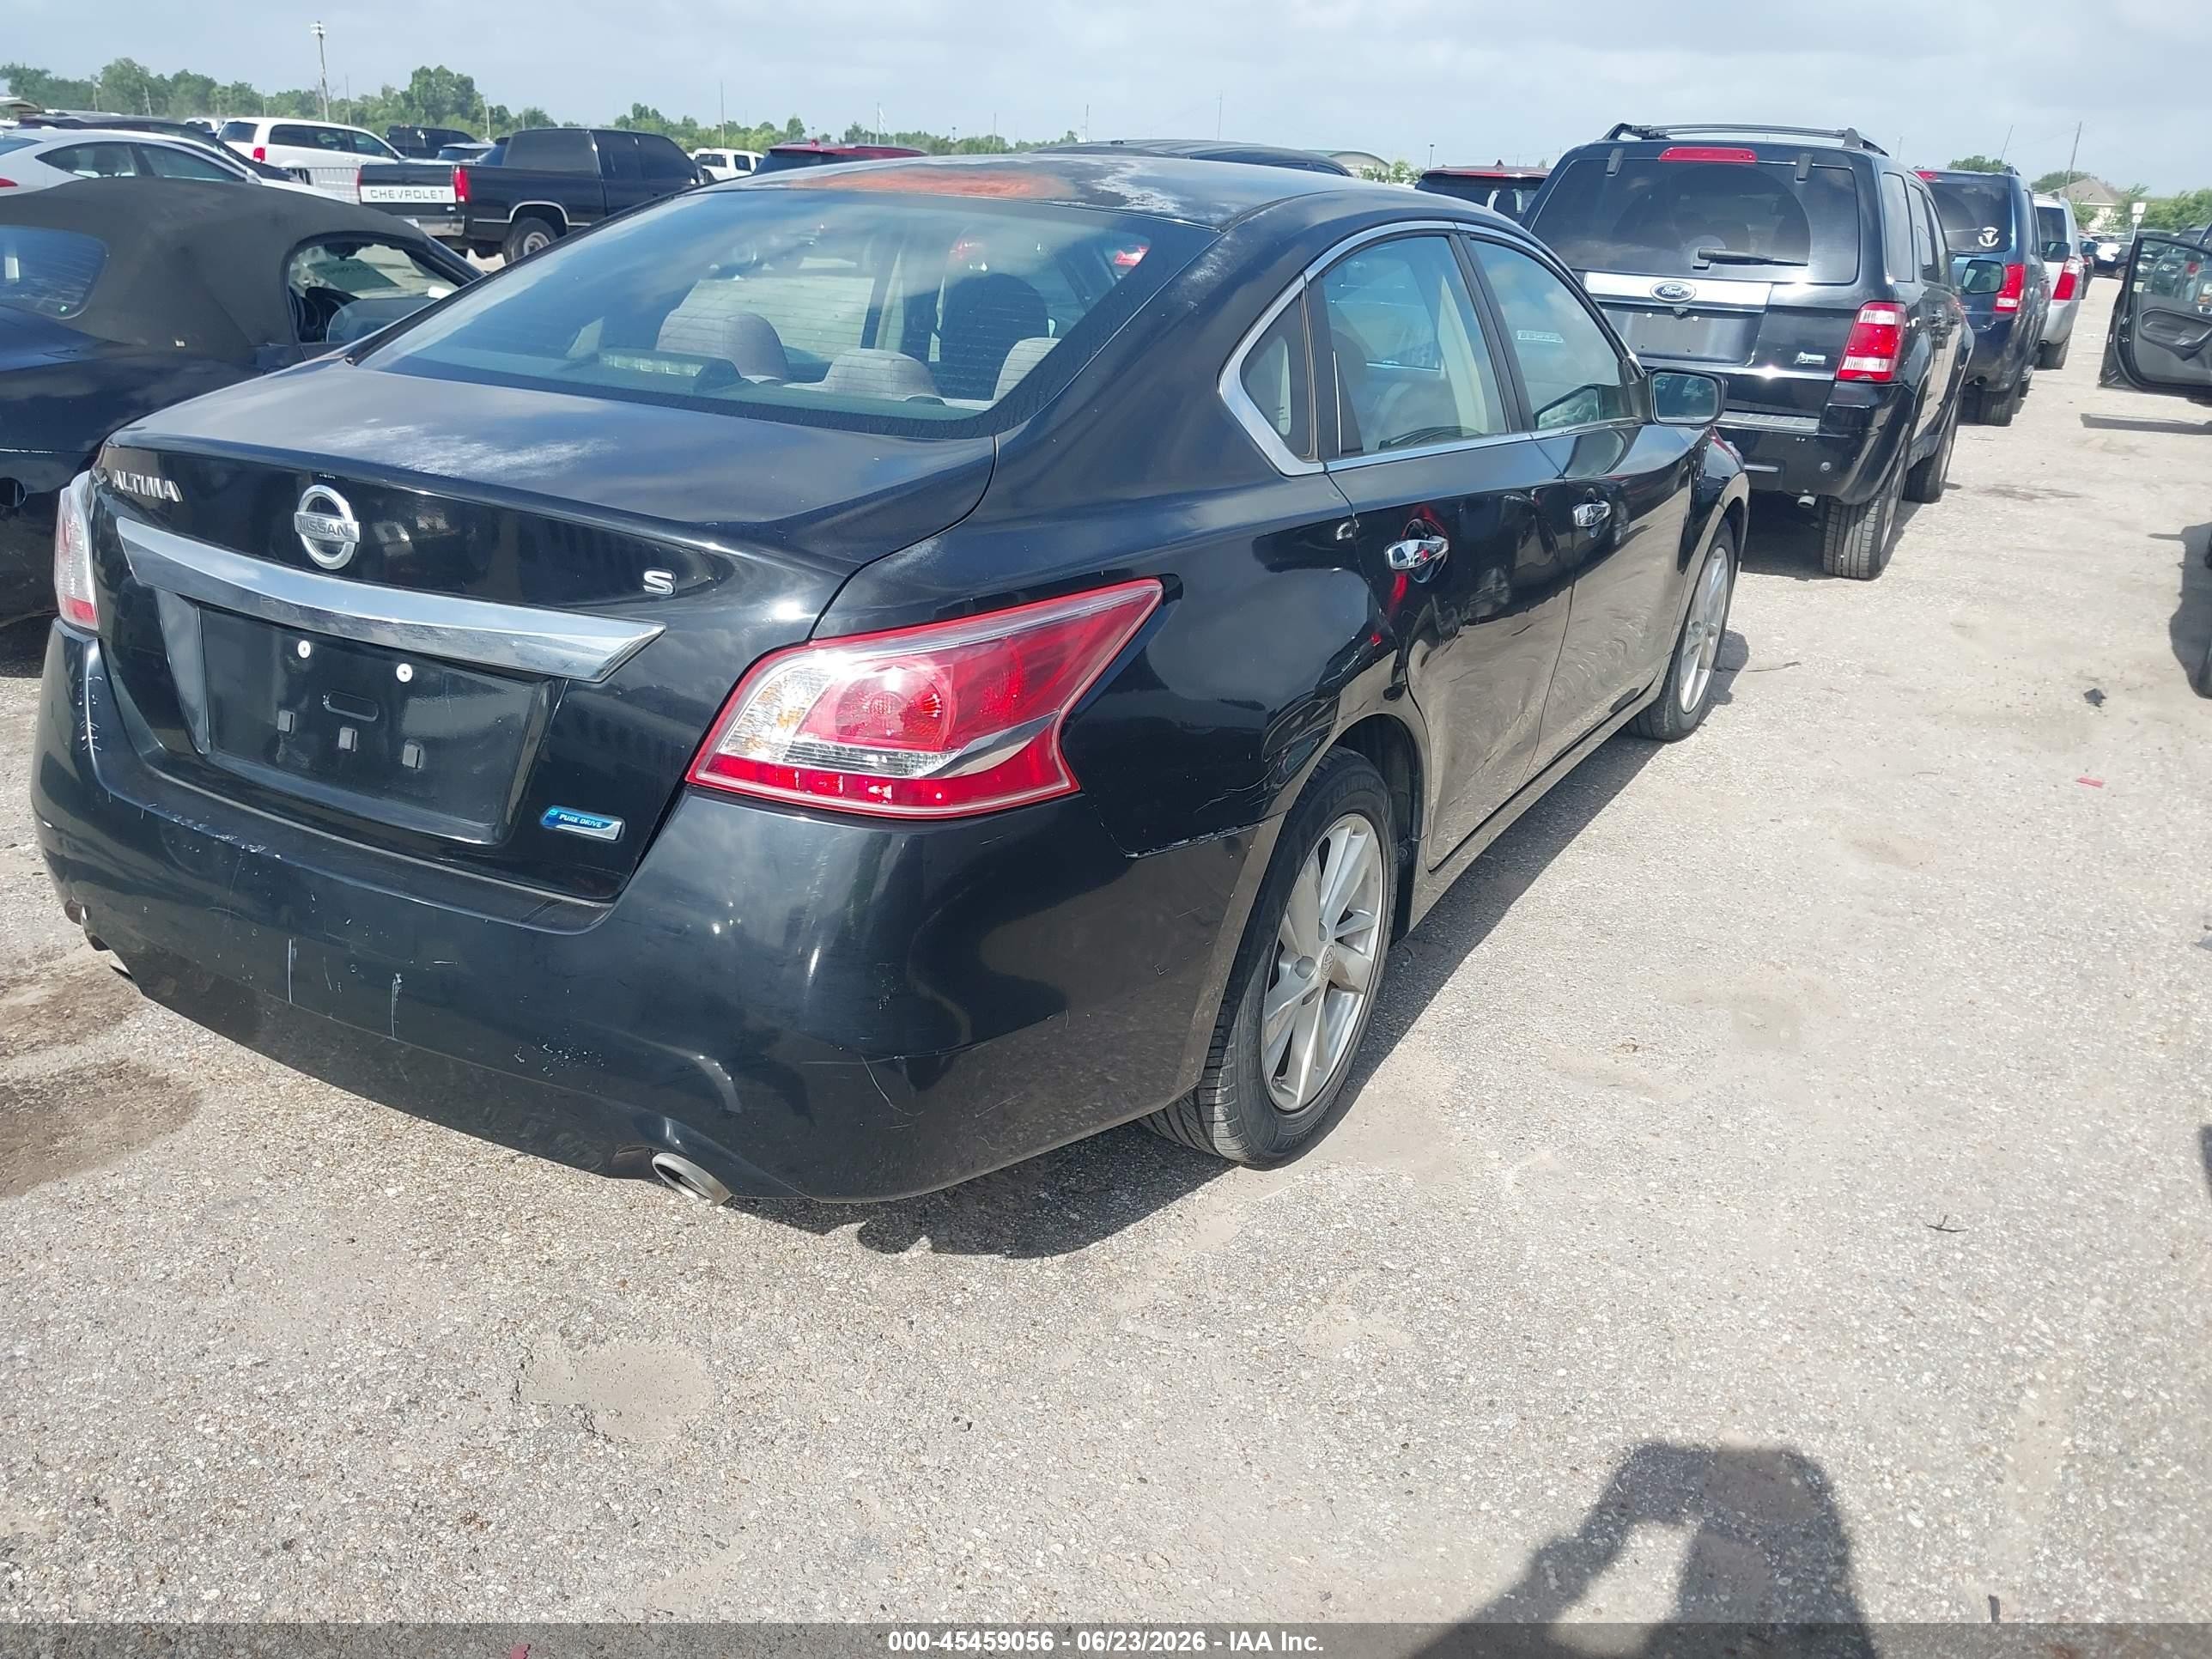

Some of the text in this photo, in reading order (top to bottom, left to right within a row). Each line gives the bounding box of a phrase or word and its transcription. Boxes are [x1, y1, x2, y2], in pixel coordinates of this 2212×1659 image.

[370, 189, 445, 200] CHEVROLET
[112, 470, 183, 502] ALTIMA
[297, 516, 349, 538] NISSAN
[643, 570, 674, 595] S
[559, 813, 603, 829] PURE DRIVE
